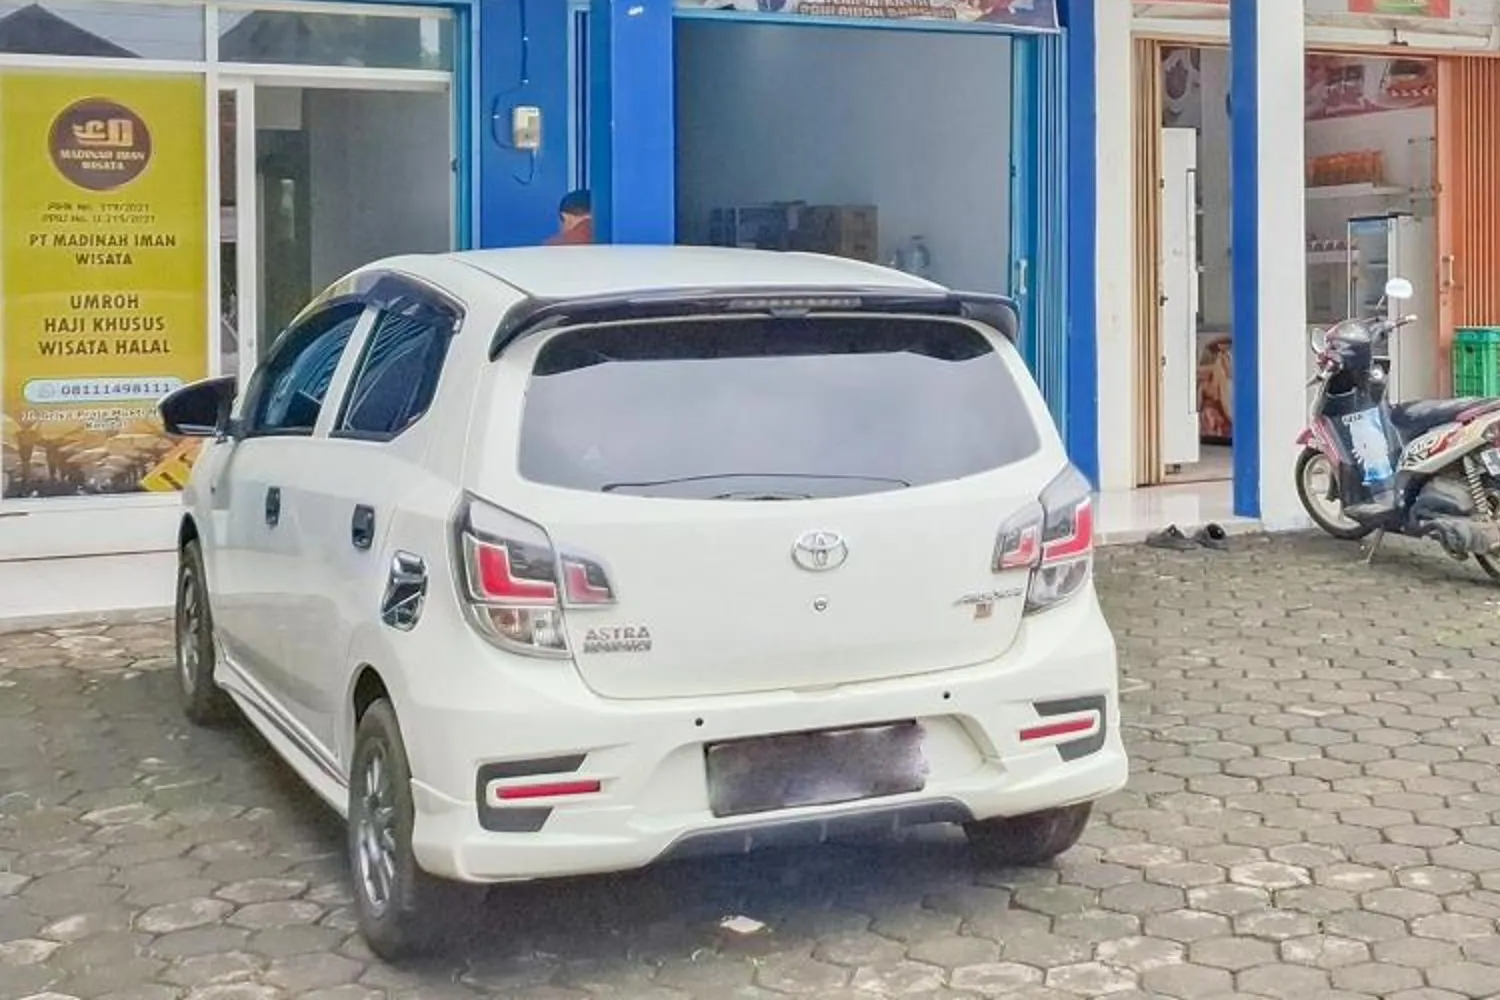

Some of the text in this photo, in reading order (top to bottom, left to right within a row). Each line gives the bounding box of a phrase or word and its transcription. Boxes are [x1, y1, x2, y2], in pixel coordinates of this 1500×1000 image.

[29, 233, 176, 247] PT MADINAH IMAN
[76, 252, 133, 265] WISATA
[70, 294, 140, 309] UMROH
[44, 316, 165, 333] HAJI KHUSUS
[38, 339, 171, 356] WISATA HALAL
[61, 383, 170, 396] 08111498111
[585, 626, 651, 641] ASTRA
